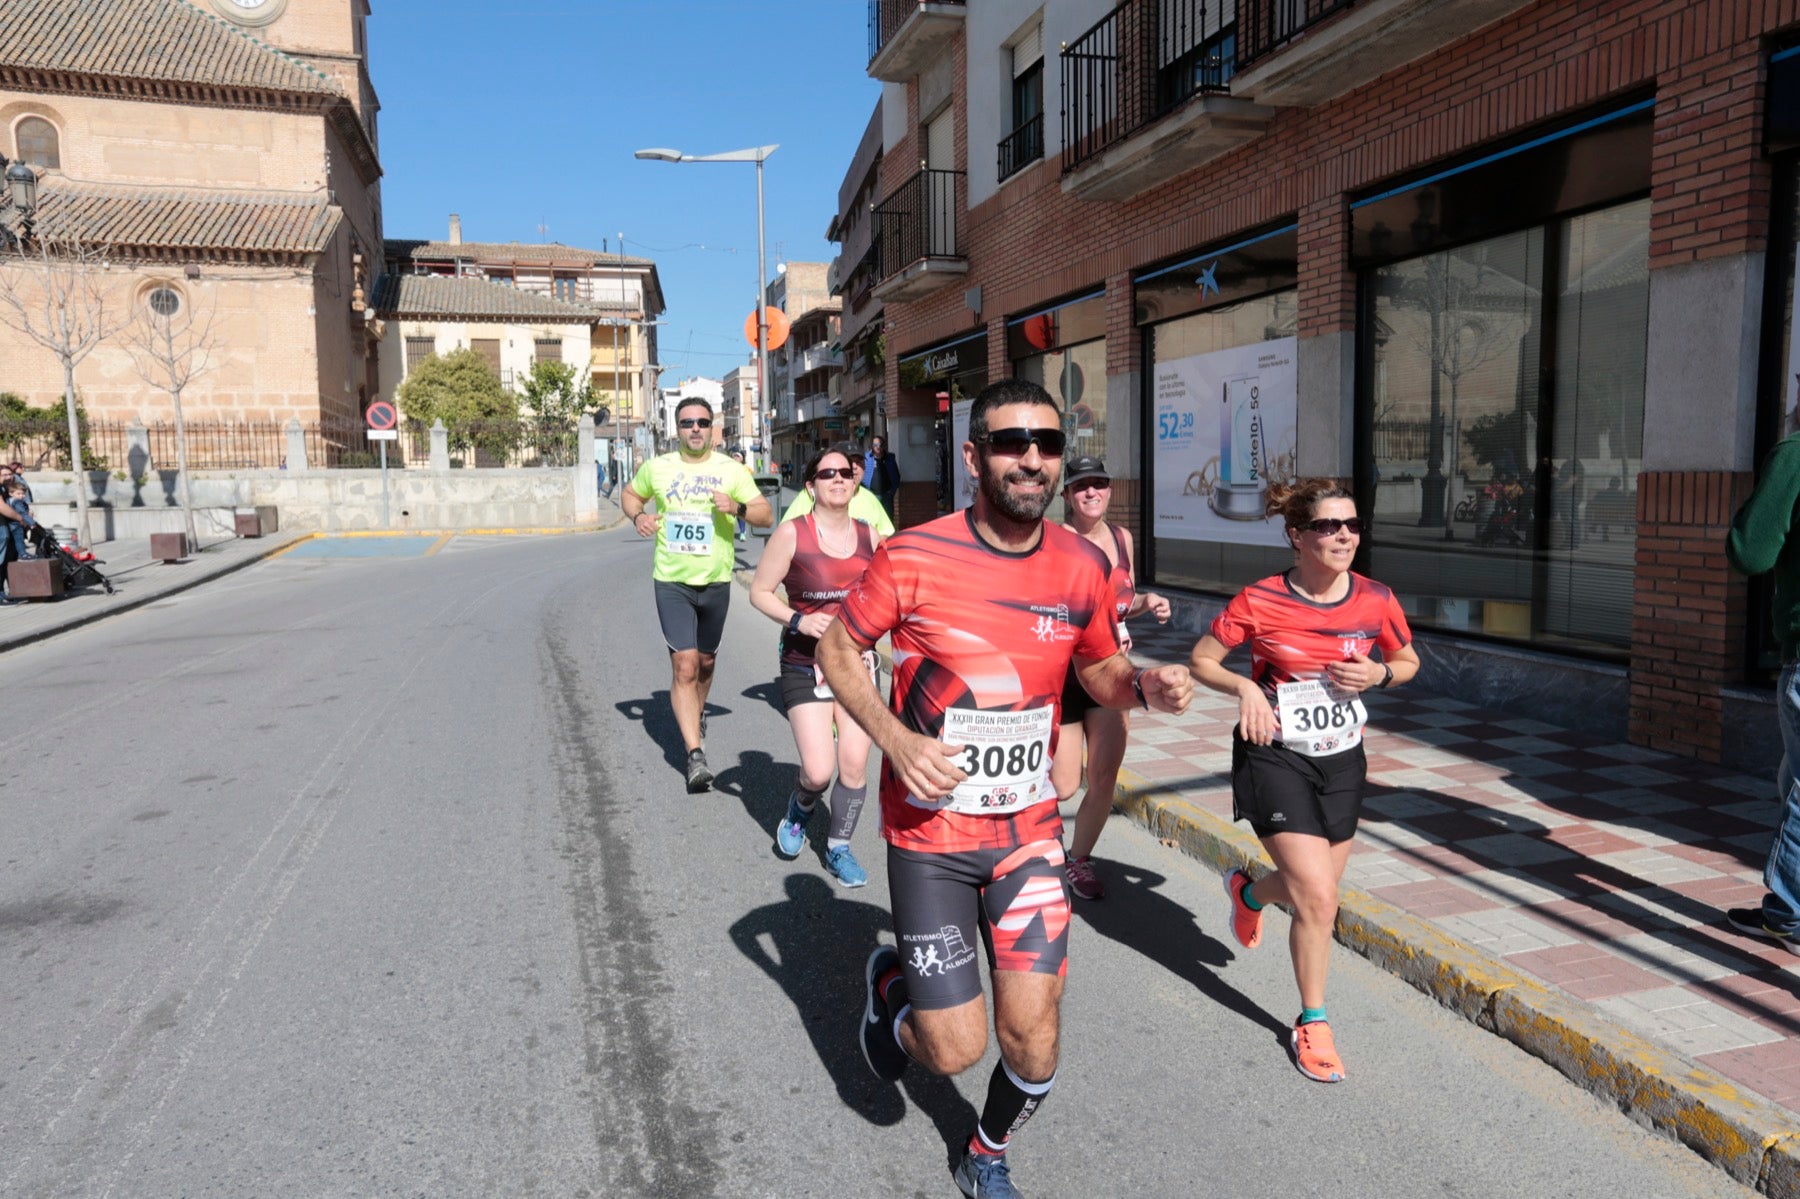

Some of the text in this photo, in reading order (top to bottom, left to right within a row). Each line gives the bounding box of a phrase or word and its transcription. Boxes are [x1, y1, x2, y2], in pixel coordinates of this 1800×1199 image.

[932, 350, 959, 371] CaixaBank
[1250, 386, 1259, 410] 5G
[674, 524, 705, 541] 765
[974, 715, 996, 725] GRAN
[996, 715, 1022, 725] PREMIO
[1023, 713, 1031, 723] DE
[1293, 700, 1358, 732] 3081
[1005, 725, 1014, 734] DE
[1014, 723, 1038, 733] GRANADA
[958, 740, 1043, 778] 3080
[903, 932, 942, 942] ATLETISMO
